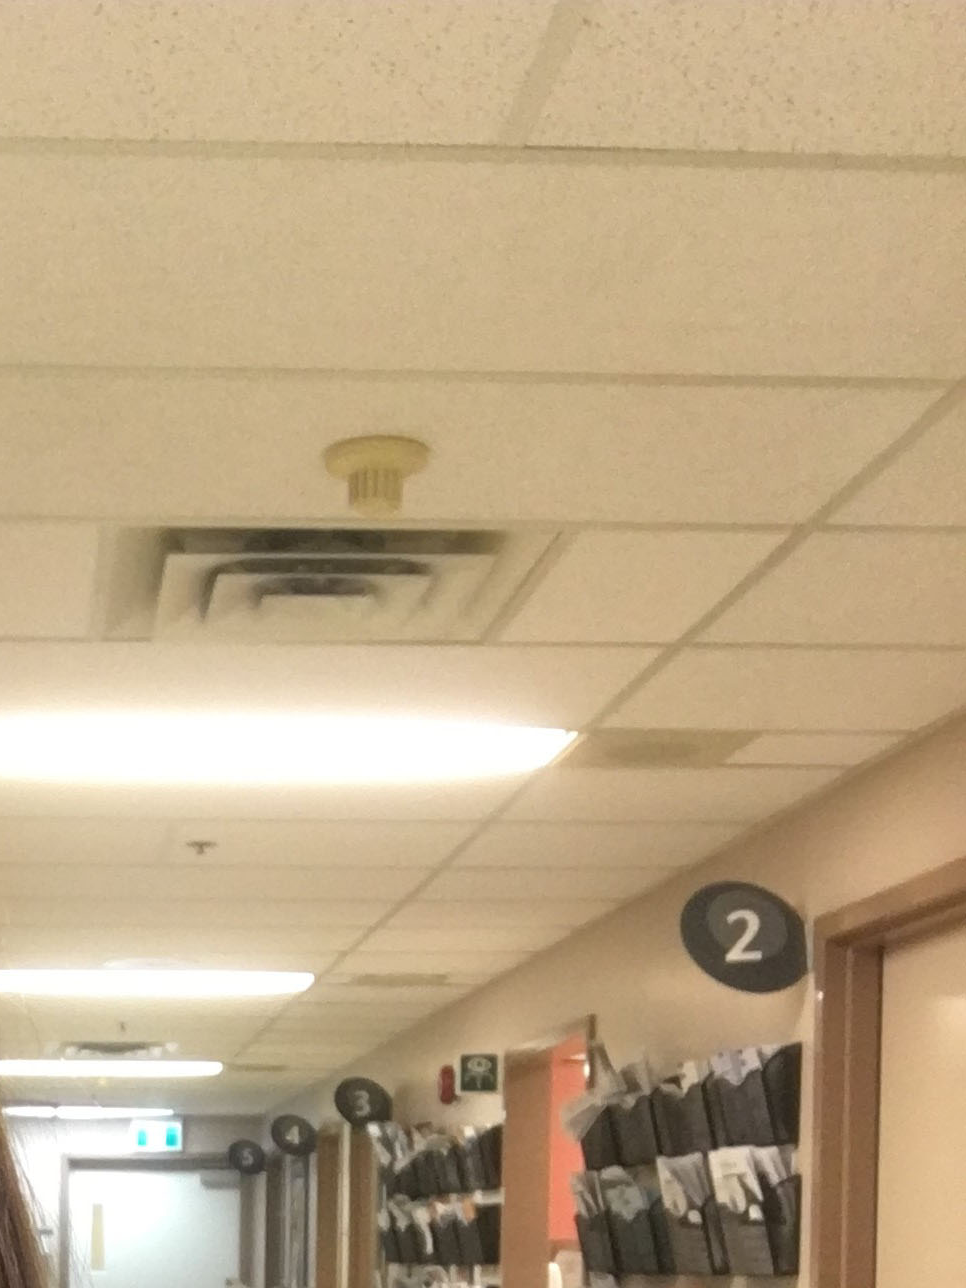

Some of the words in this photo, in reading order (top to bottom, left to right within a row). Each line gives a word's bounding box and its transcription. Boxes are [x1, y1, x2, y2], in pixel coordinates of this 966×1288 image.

[725, 908, 763, 963] 2
[354, 1090, 371, 1117] 3
[285, 1125, 300, 1145] 4
